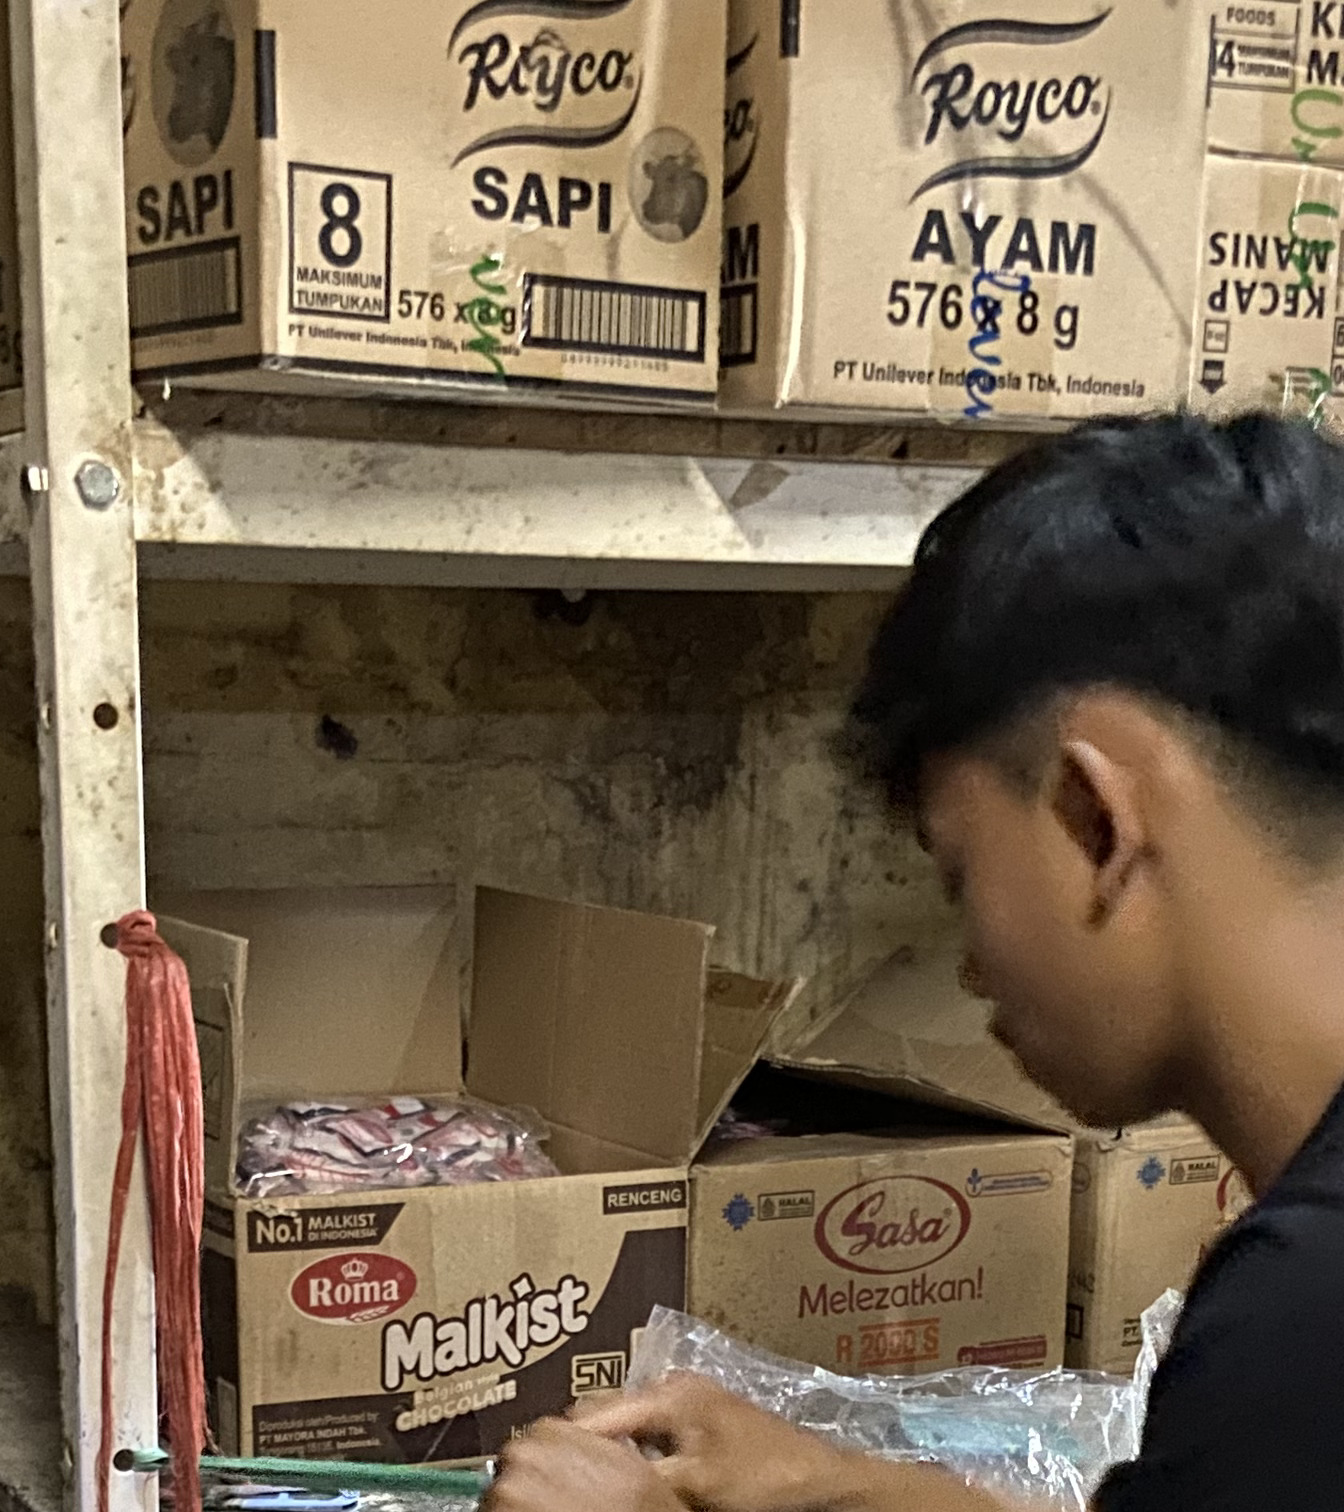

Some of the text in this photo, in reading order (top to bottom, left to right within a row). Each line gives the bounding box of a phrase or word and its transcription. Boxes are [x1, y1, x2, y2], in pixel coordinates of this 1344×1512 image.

[1226, 6, 1276, 27] FOODS
[461, 29, 631, 113] Royco
[920, 63, 1100, 145] Royco
[137, 169, 233, 246] SAPI
[470, 164, 612, 235] SAPI
[318, 182, 363, 268] 8
[910, 208, 1097, 277] AYAM
[1208, 231, 1328, 274] MANIS
[296, 266, 383, 290] MAKSIMUM
[296, 289, 383, 313] TUMPUKAN
[1208, 278, 1326, 320] KECAP
[288, 322, 304, 338] PT
[308, 325, 362, 342] Unilever
[366, 332, 427, 349] Indonesia
[397, 288, 446, 322] 576
[500, 304, 517, 335] g
[886, 280, 964, 331] 576
[1016, 290, 1040, 336] 8
[1053, 303, 1080, 351] g
[833, 360, 1145, 398] PT Unilever Tbk, Indonesia
[606, 1187, 683, 1208] RENCENG
[255, 1211, 376, 1245] No.1 MALKIST
[840, 1190, 952, 1256] Sasa
[308, 1277, 400, 1307] Roma
[797, 1265, 984, 1319] Melezatkan!
[383, 1273, 591, 1391] Malkist
[395, 1380, 517, 1432] CHOCOLATE
